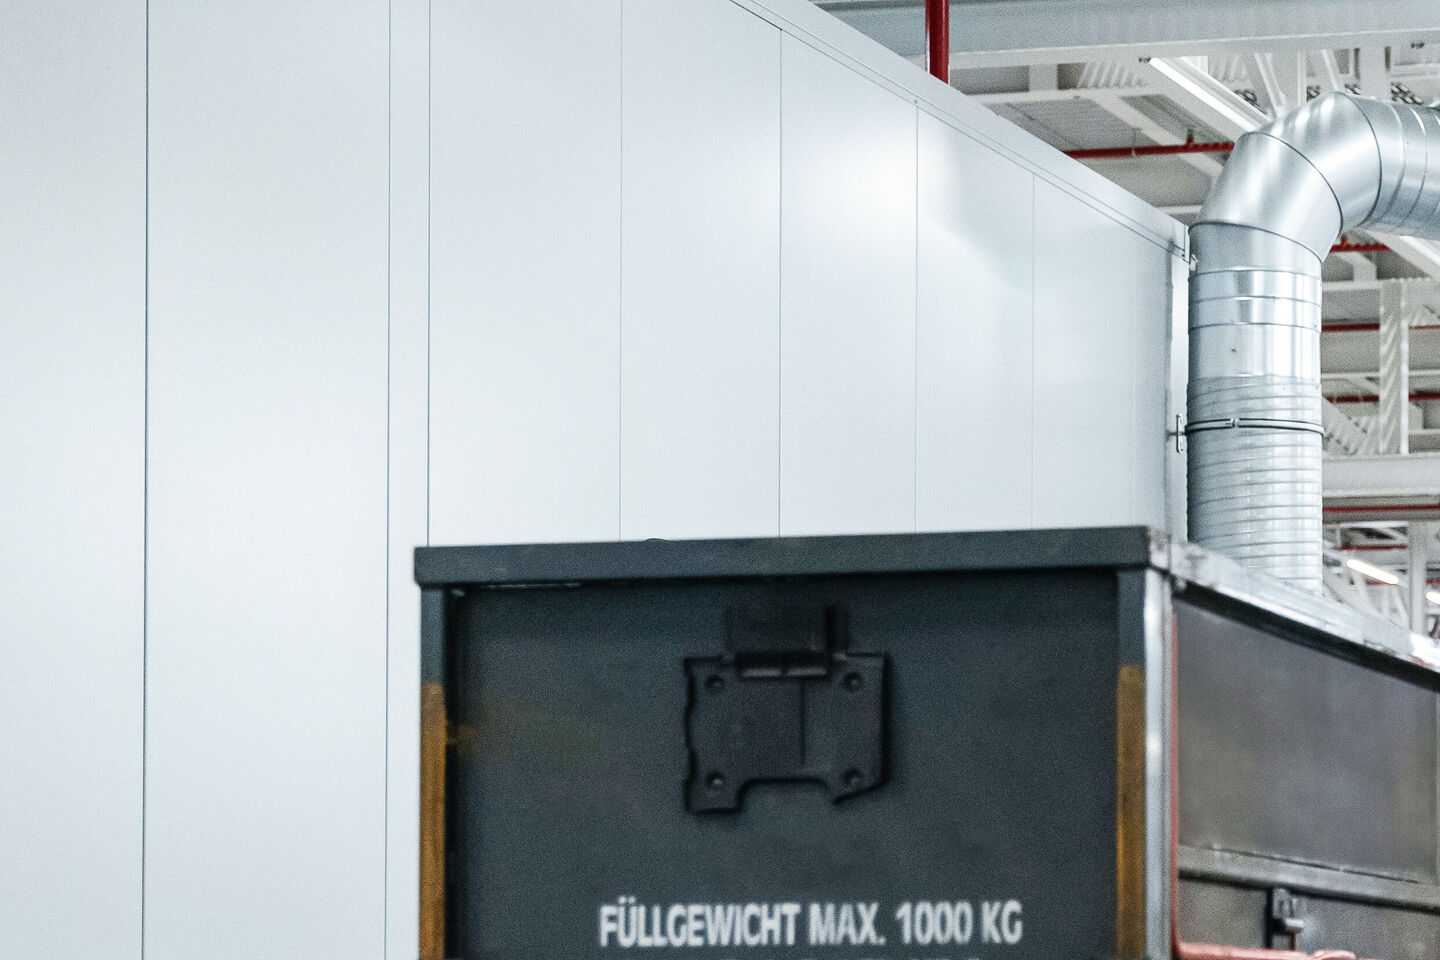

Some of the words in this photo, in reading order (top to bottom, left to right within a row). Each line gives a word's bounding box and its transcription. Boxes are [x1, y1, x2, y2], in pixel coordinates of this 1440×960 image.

[600, 896, 801, 946] FÜLLGEWICHT
[809, 903, 886, 945] MAX.
[896, 902, 972, 943] 1000
[981, 900, 1022, 943] KG
